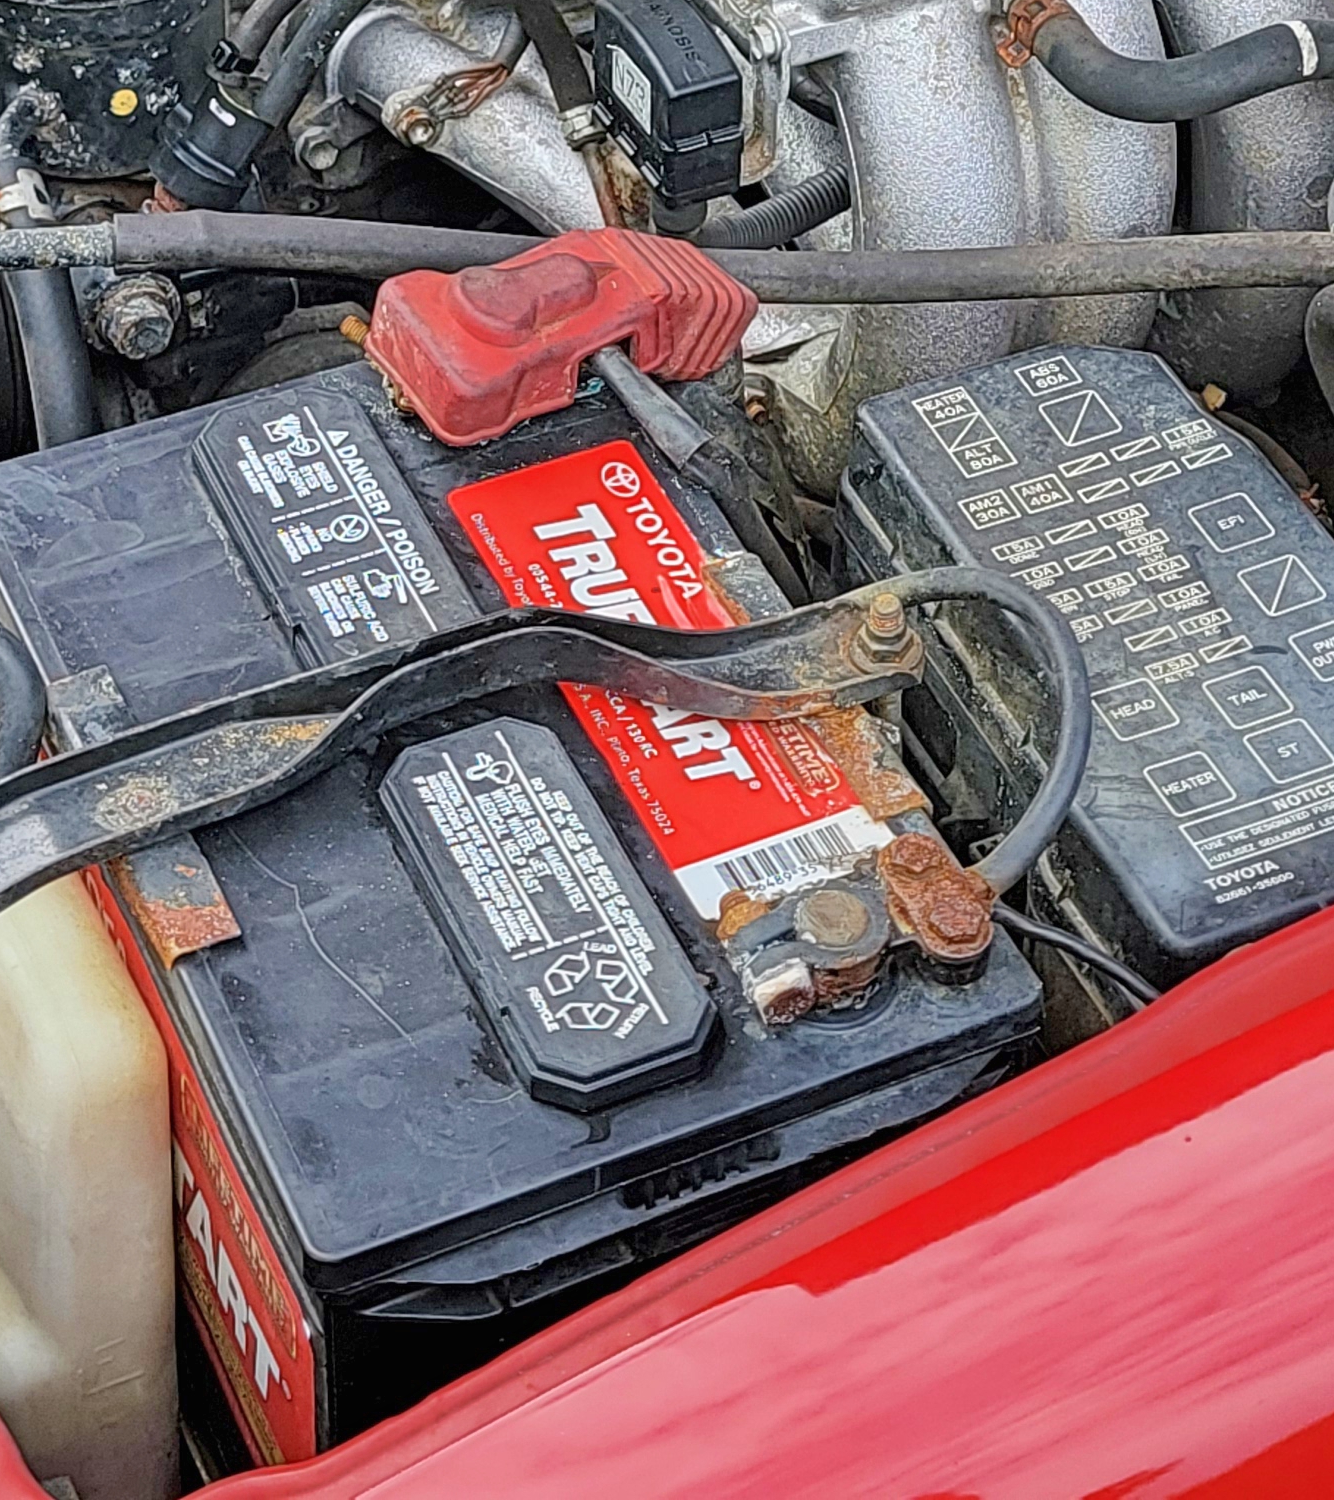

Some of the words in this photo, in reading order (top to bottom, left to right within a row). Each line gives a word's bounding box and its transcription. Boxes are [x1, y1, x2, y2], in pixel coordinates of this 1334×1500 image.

[1030, 363, 1060, 379] ABS
[1035, 373, 1069, 388] 60A
[916, 390, 969, 414] HEATER
[935, 404, 967, 419] 40A
[965, 443, 992, 460] ALT
[970, 454, 1003, 470] 80A
[336, 444, 391, 515] DANGER
[1021, 481, 1052, 497] AM1
[1030, 491, 1063, 505] 40A
[969, 495, 1003, 513] AM2
[375, 514, 401, 529] /
[976, 508, 1010, 523] 30A
[1109, 508, 1141, 524] 10A
[1217, 515, 1245, 530] EFI
[316, 528, 332, 542] NO
[1127, 532, 1160, 549] 10A
[626, 497, 703, 599] TOYOTA
[385, 528, 439, 594] POISON
[1146, 557, 1181, 575] 10A
[1019, 565, 1055, 582] 10A
[1103, 586, 1130, 601] STOP
[1166, 585, 1202, 602] 10A
[342, 575, 376, 619] SULFURIC
[366, 621, 389, 641] ACID
[1187, 611, 1221, 629] 10A
[471, 513, 510, 565] Distributed
[500, 565, 517, 578] by
[625, 767, 655, 800] Texas
[646, 801, 675, 837] 75024
[1228, 689, 1267, 707] TAIL
[1110, 699, 1156, 719] HEAD
[626, 723, 646, 742] 130
[1277, 742, 1300, 758] ST
[1162, 772, 1215, 796] HEATER
[490, 788, 516, 816] WITH
[528, 857, 552, 877] GET
[1227, 831, 1249, 842] THE
[1250, 808, 1310, 835] DESIGNATED
[474, 793, 509, 839] MEDICAL
[500, 838, 526, 865] HELP
[516, 867, 543, 893] FAST
[505, 783, 535, 817] FLUSH
[524, 818, 550, 845] EYES
[540, 846, 591, 912] IMMEDIATELY
[530, 777, 546, 791] DO
[538, 791, 558, 810] NOT
[561, 828, 581, 851] KEEP
[574, 851, 596, 874] VENT
[588, 875, 609, 899] CAPS
[603, 899, 626, 925] TIGHT
[618, 928, 637, 946] AND
[552, 790, 572, 811] KEEP
[566, 813, 584, 830] OUT
[577, 833, 593, 844] OF
[585, 846, 604, 865] THE
[596, 865, 621, 894] REACH
[613, 894, 630, 906] OF
[622, 909, 655, 952] CHILDREN
[1202, 860, 1279, 890] TOYOTA
[584, 942, 616, 954] LEAD
[526, 987, 559, 1032] RECYCLE
[614, 1003, 649, 1038] RETURN
